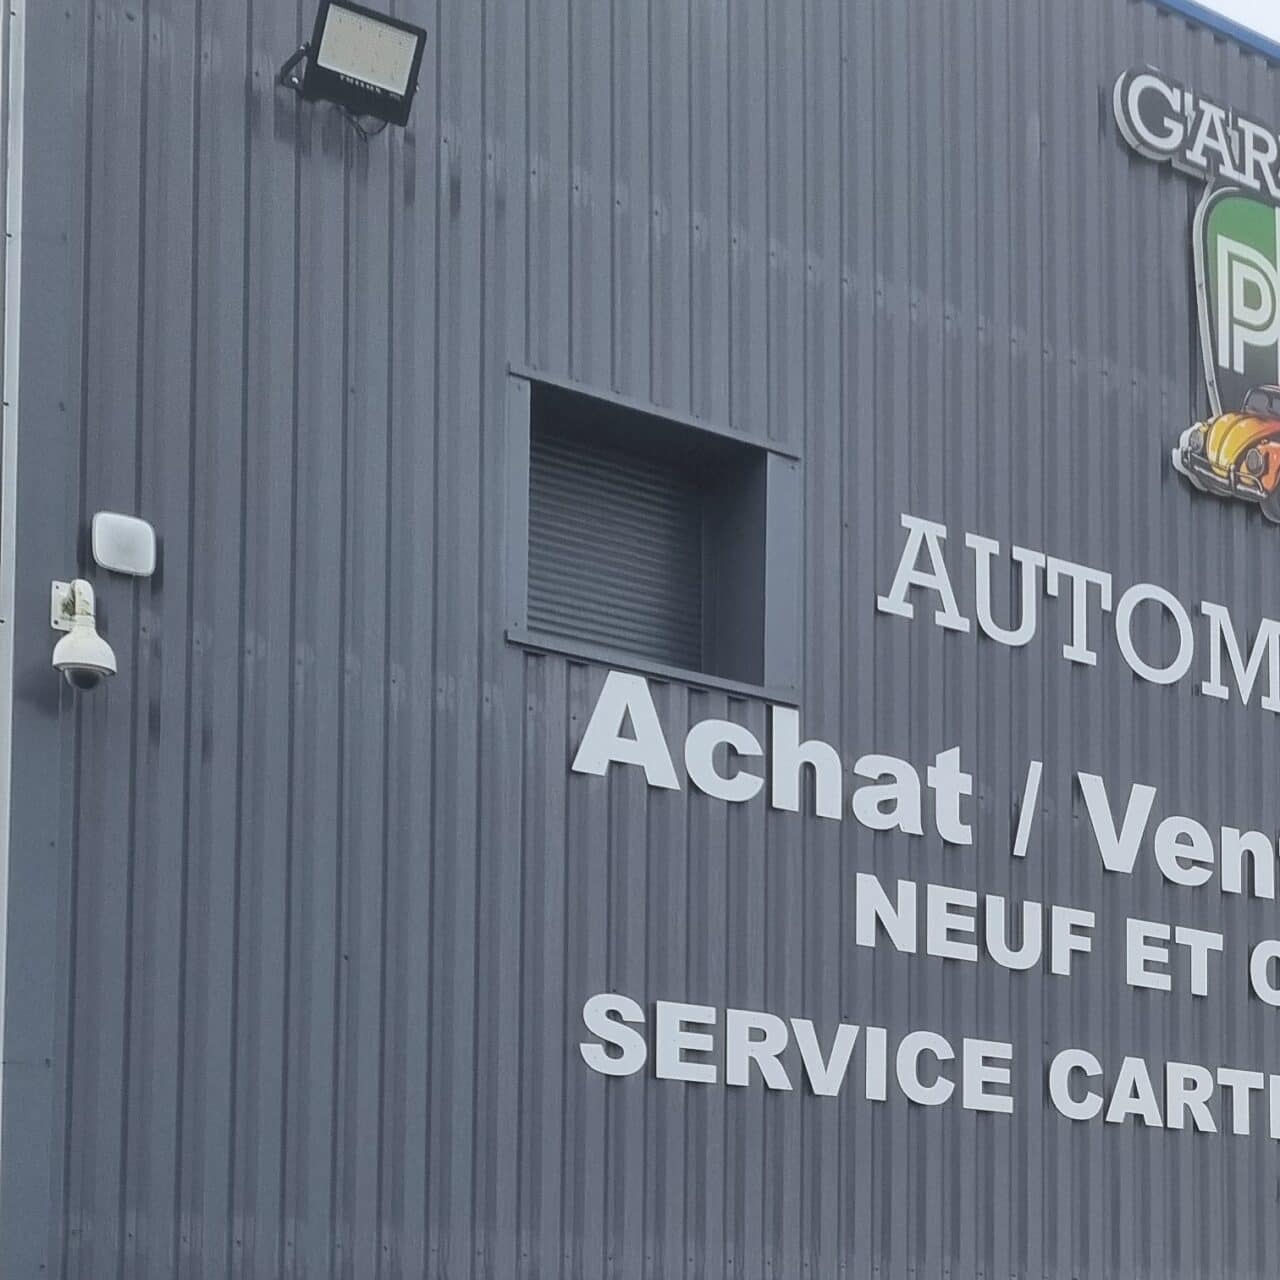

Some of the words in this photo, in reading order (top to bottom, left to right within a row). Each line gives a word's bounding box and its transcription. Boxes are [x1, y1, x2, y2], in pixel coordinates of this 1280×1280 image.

[571, 670, 973, 846] Achat
[1013, 760, 1043, 857] /
[855, 872, 1096, 976] NEUF
[1126, 917, 1224, 997] ET
[579, 993, 1014, 1114] SERVICE
